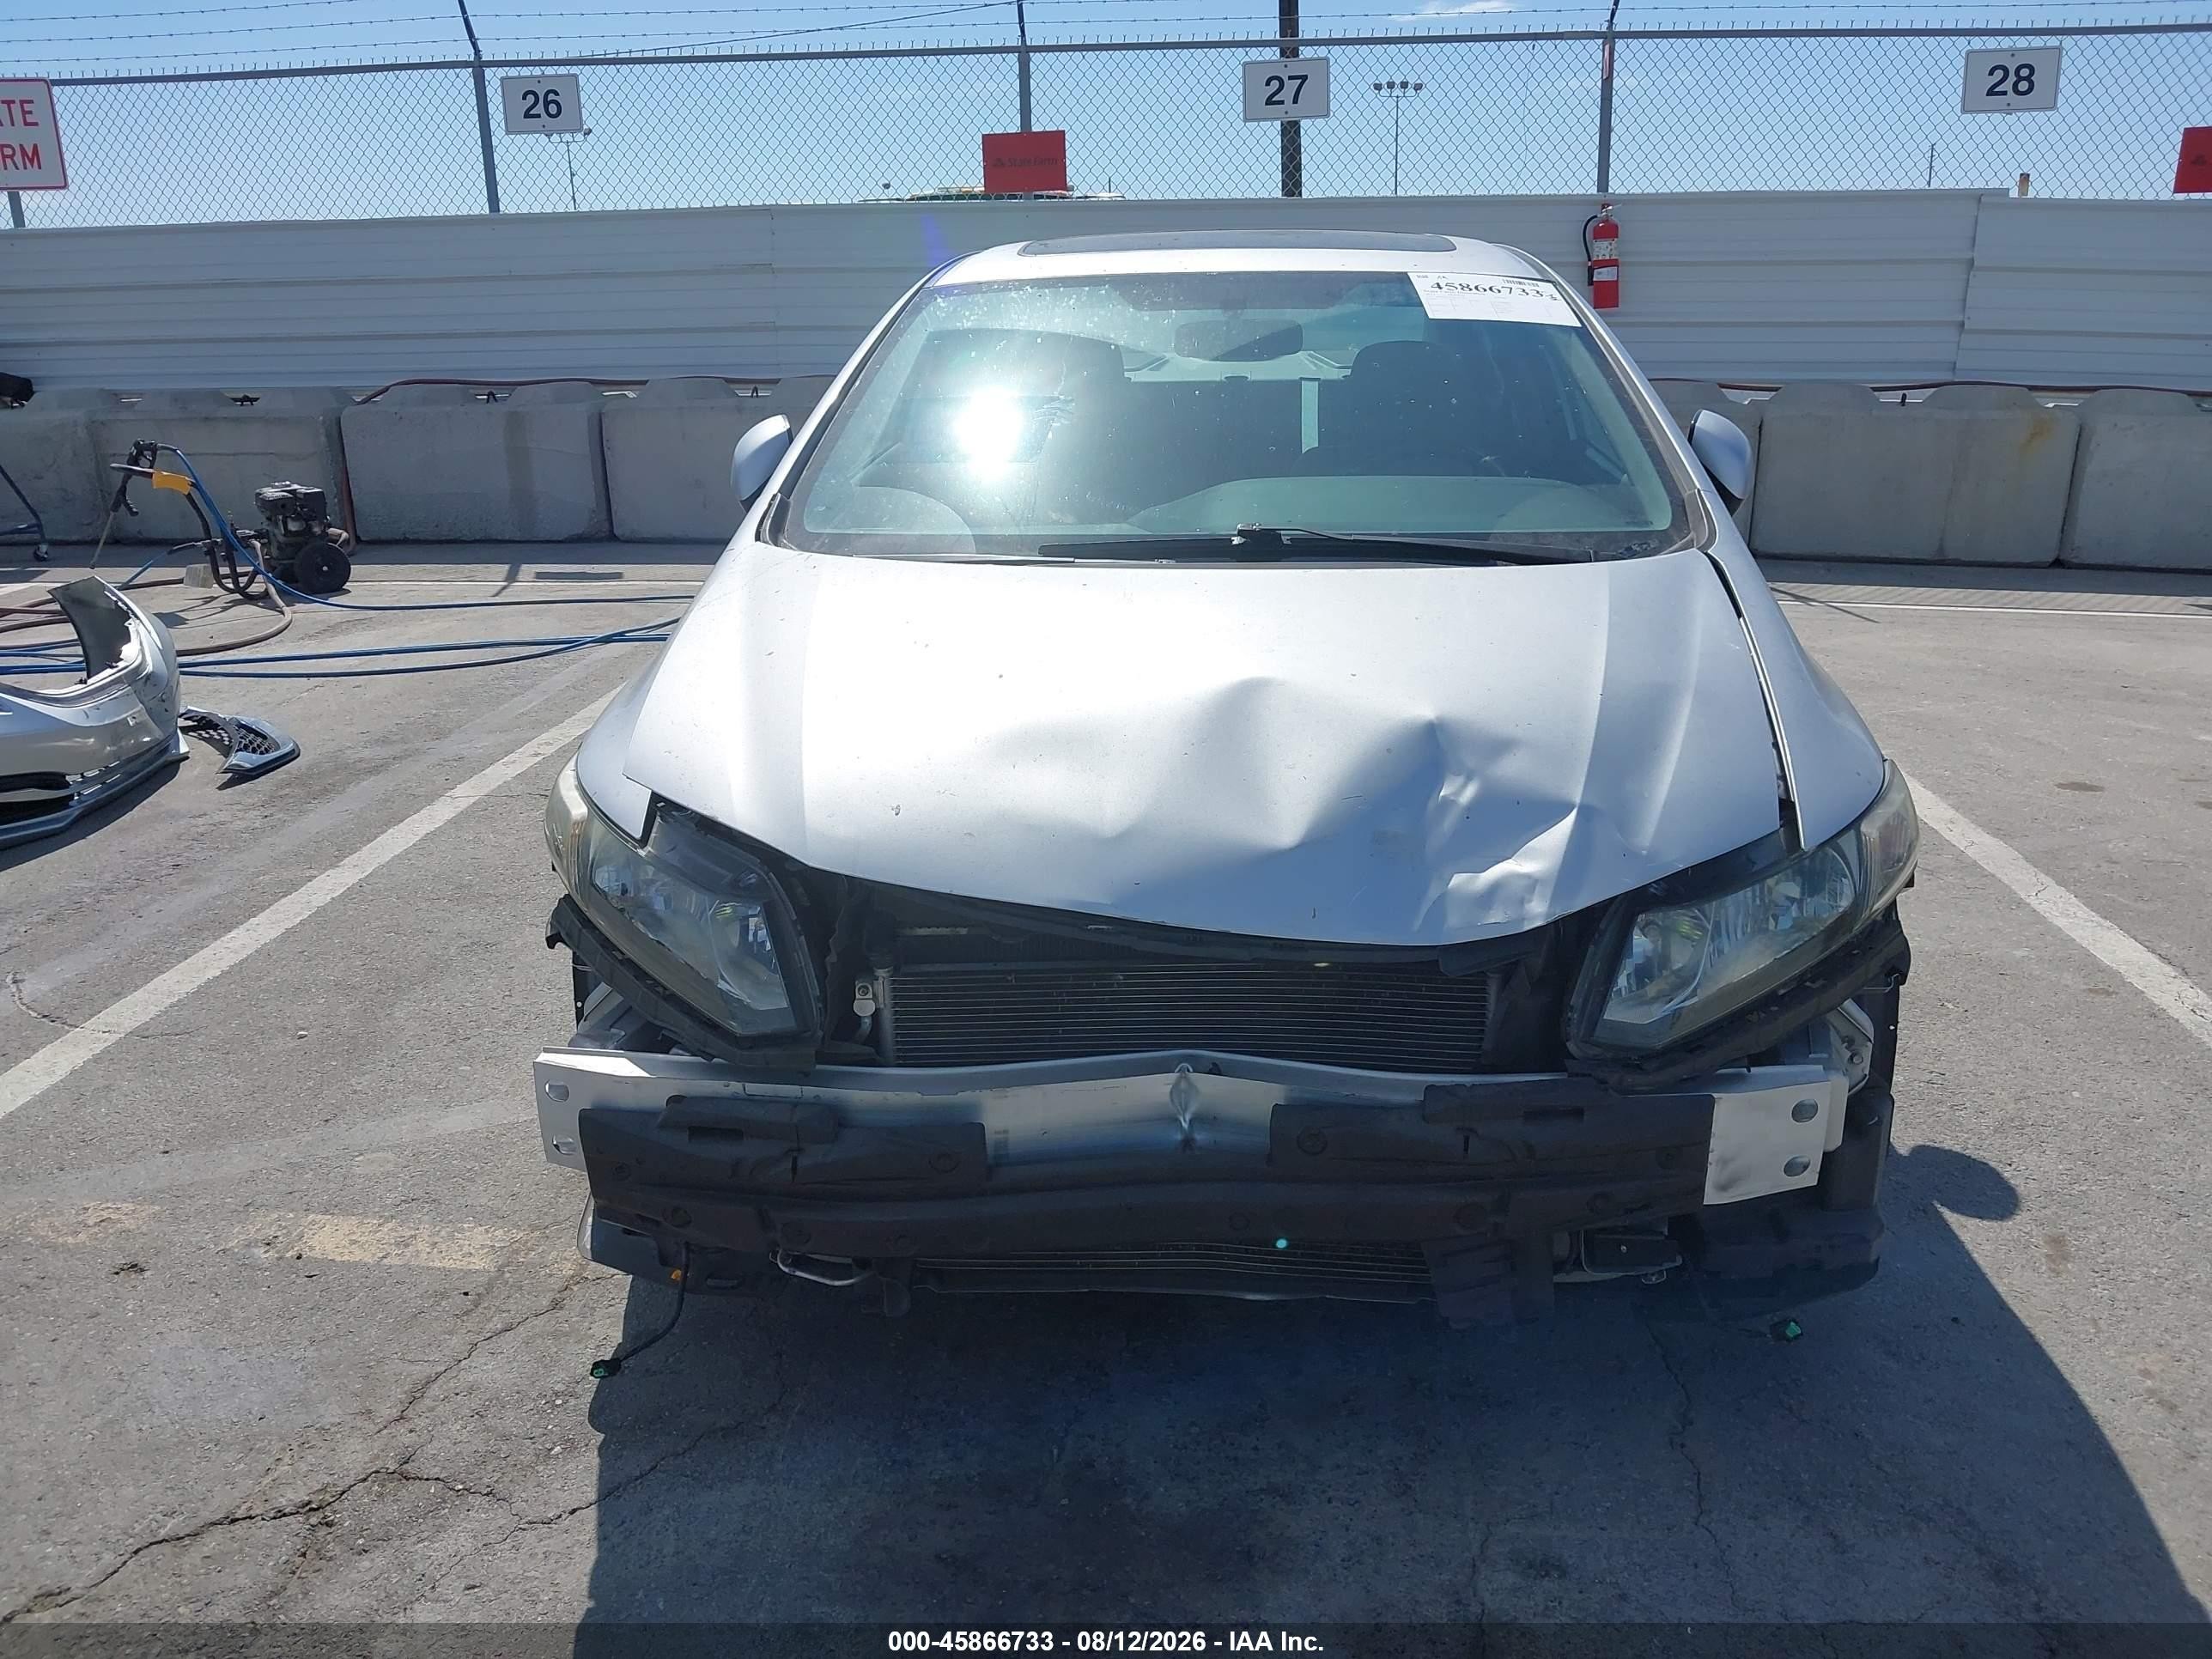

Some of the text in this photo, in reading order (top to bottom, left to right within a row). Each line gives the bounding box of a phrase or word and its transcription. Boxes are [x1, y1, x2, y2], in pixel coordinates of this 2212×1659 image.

[1264, 74, 1309, 106] 27
[1985, 63, 2036, 96] 28
[0, 99, 40, 127] TE
[521, 88, 562, 118] 26
[1431, 282, 1544, 298] 45866733
